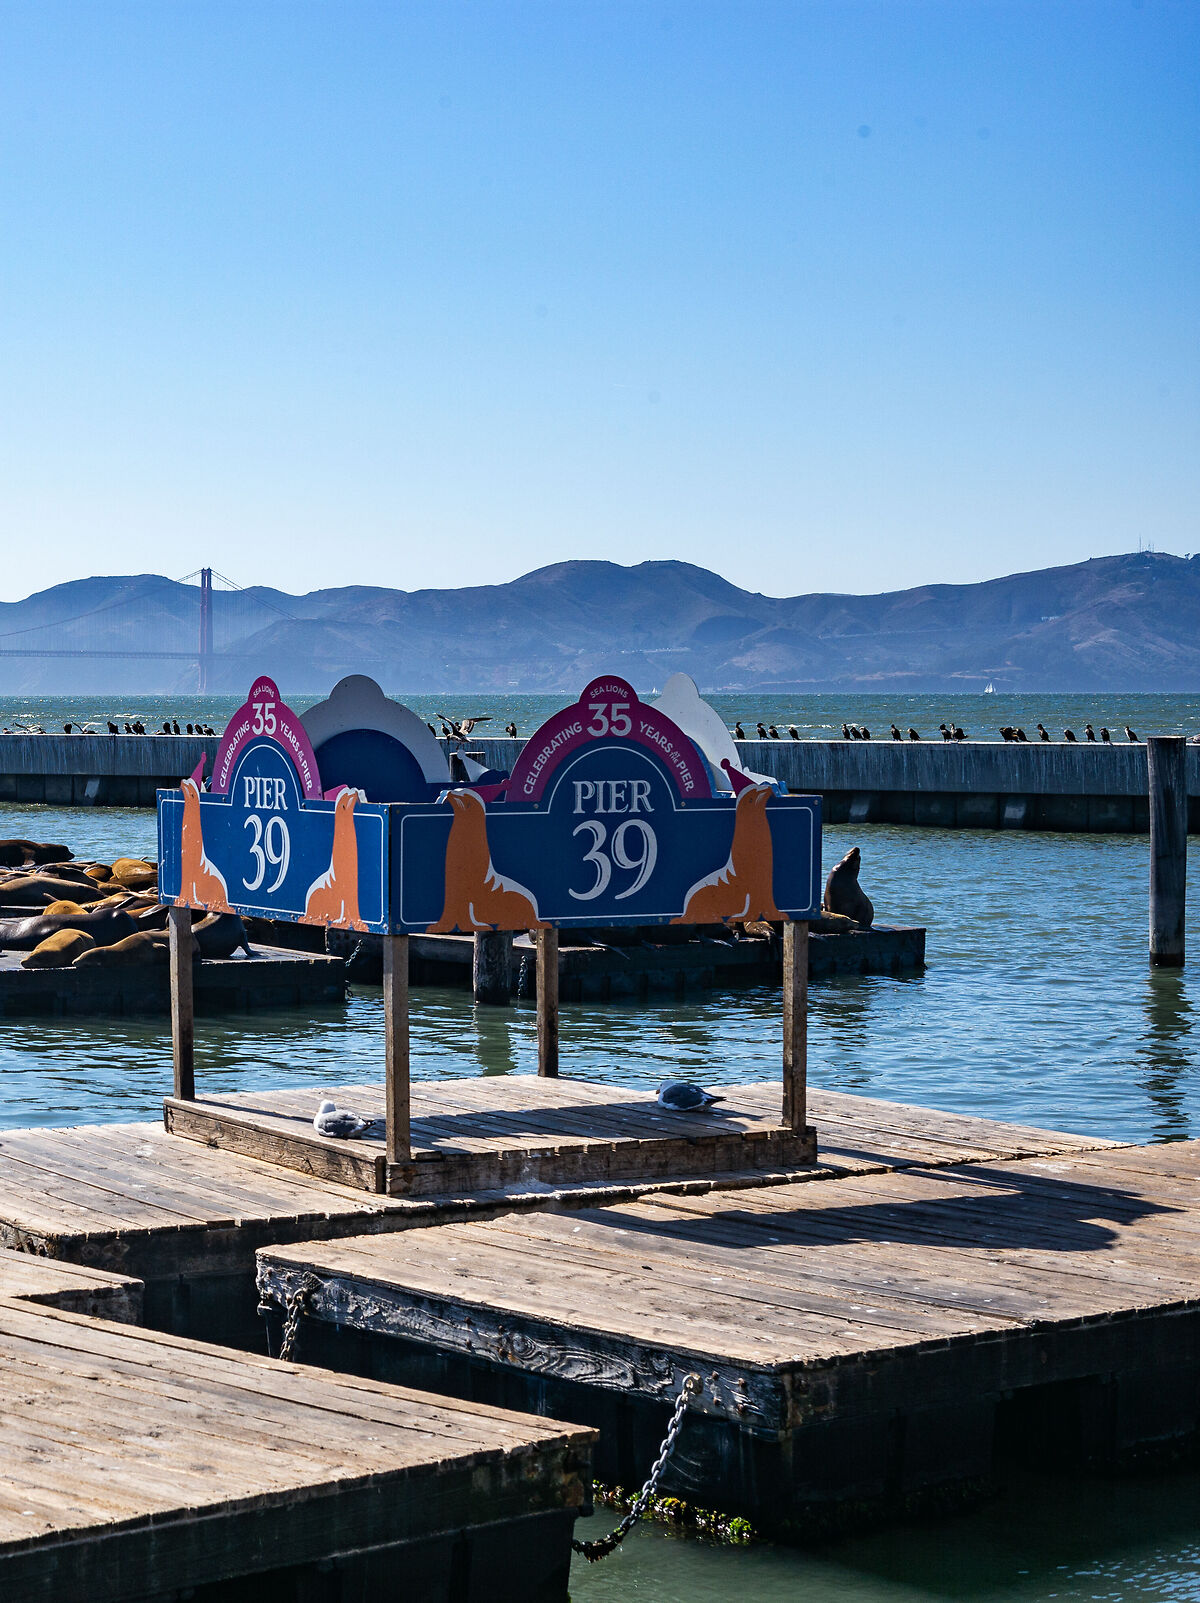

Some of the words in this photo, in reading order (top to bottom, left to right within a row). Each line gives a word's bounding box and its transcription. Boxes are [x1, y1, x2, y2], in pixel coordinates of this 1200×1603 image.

[590, 686, 605, 699] SEA
[606, 685, 629, 698] LIONS
[220, 720, 250, 788] CELEBRATING
[252, 702, 277, 735] 35
[280, 720, 300, 752] YEARS
[524, 721, 583, 795] CELEBRATING
[587, 703, 632, 737] 35
[639, 721, 673, 753] YEARS
[301, 760, 313, 791] PIER
[676, 760, 695, 792] PIER
[243, 776, 288, 811] PIER
[572, 779, 655, 814] PIER
[242, 814, 291, 894] 39
[568, 818, 658, 901] 39
